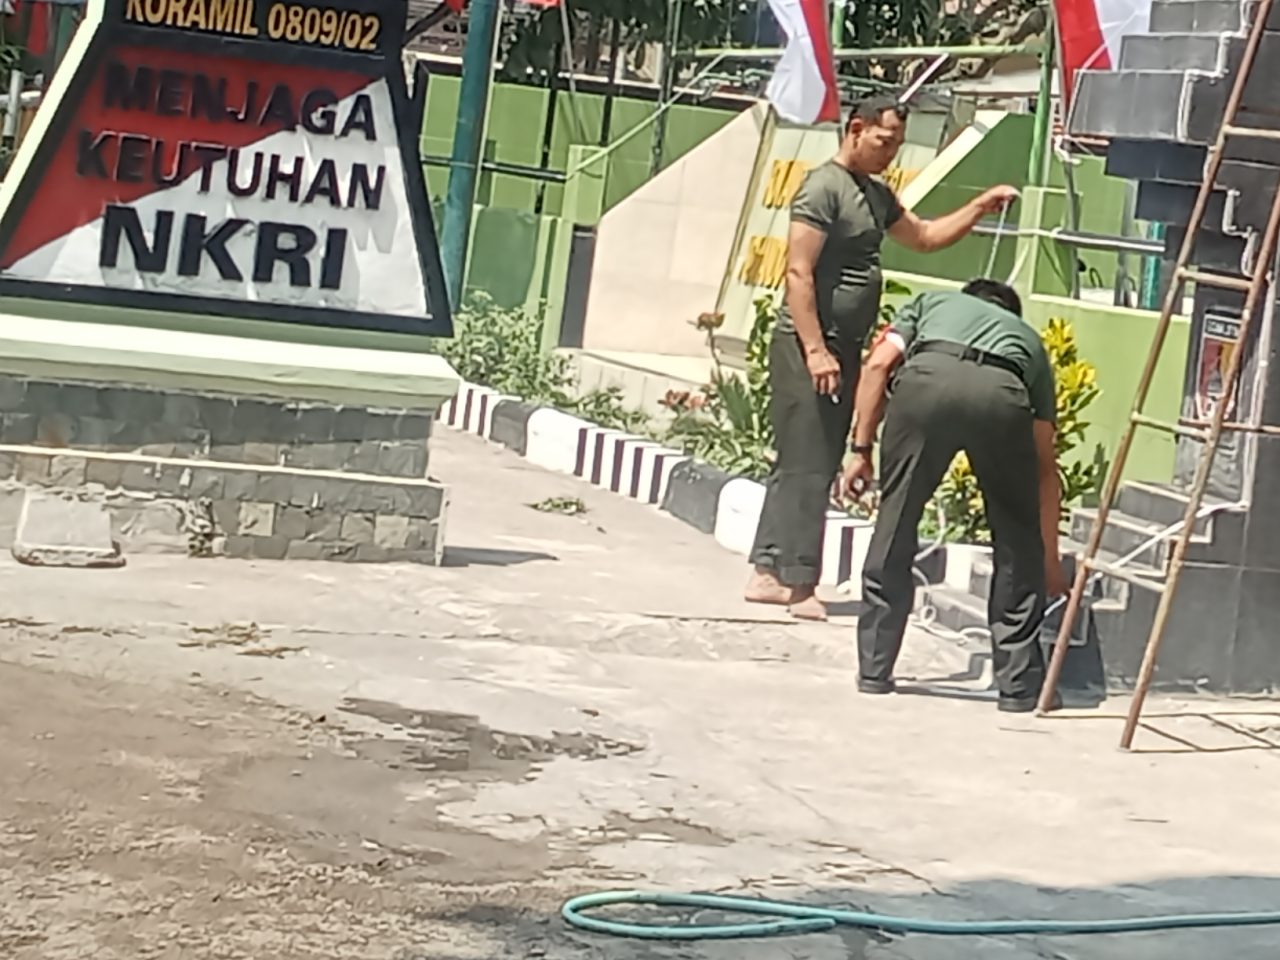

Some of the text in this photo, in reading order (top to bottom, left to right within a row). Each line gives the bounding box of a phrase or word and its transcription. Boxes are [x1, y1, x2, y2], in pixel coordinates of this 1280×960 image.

[267, 2, 381, 51] 0809/02
[104, 63, 378, 142] MENJAGA
[76, 129, 387, 212] KEUTUHAN
[101, 204, 349, 291] NKRI
